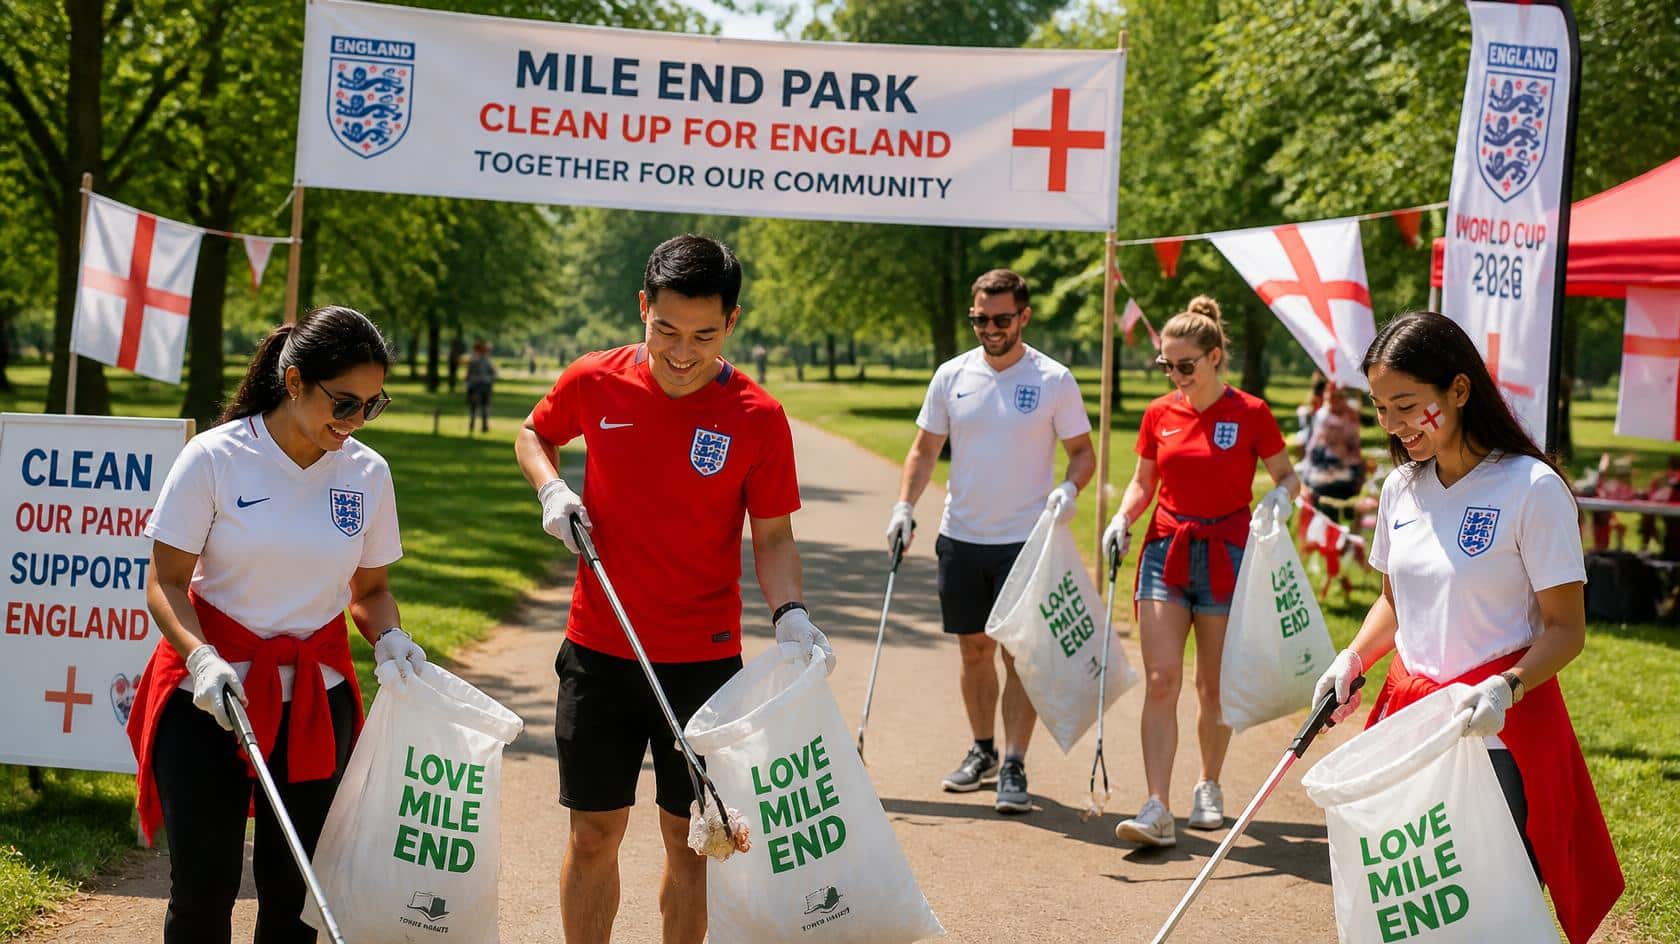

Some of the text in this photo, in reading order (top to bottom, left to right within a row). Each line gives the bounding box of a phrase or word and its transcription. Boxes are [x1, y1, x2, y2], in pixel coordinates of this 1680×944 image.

[334, 39, 412, 57] ENGLAND
[1489, 47, 1556, 71] ENGLAND
[516, 50, 918, 114] MILE END PARK
[479, 102, 952, 159] CLEAN UP FOR ENGLAND
[474, 149, 953, 199] TOGETHER FOR OUR COMMUNITY
[1514, 222, 1547, 251] CUP
[21, 448, 153, 492] CLEAN
[15, 501, 154, 538] OUR PARK
[9, 551, 151, 591] SUPPORT
[5, 601, 149, 641] ENGLAND
[404, 745, 486, 796] LOVE
[751, 735, 831, 796] LOVE
[398, 785, 481, 834] MILE
[759, 772, 840, 835] MILE
[393, 825, 476, 874] END
[767, 814, 847, 875] END
[1360, 801, 1452, 867] LOVE
[1367, 839, 1463, 904] MILE
[1376, 883, 1470, 944] END
